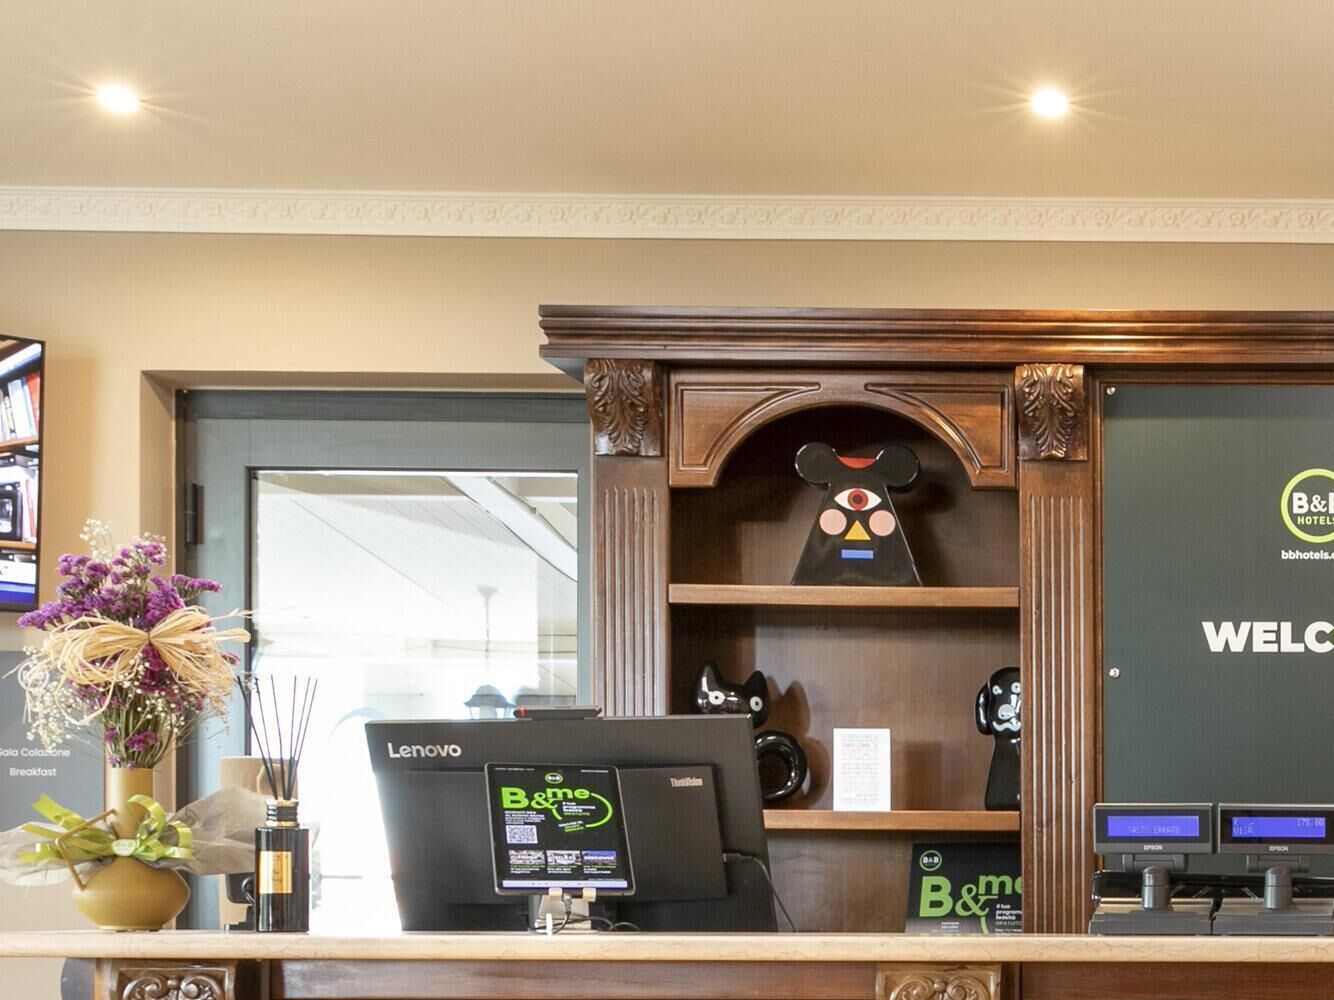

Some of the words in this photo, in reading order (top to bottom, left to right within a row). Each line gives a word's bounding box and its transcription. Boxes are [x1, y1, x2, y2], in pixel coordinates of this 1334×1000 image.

[387, 742, 462, 758] Lenovo
[9, 767, 57, 776] Breakfast
[501, 787, 590, 809] B&me
